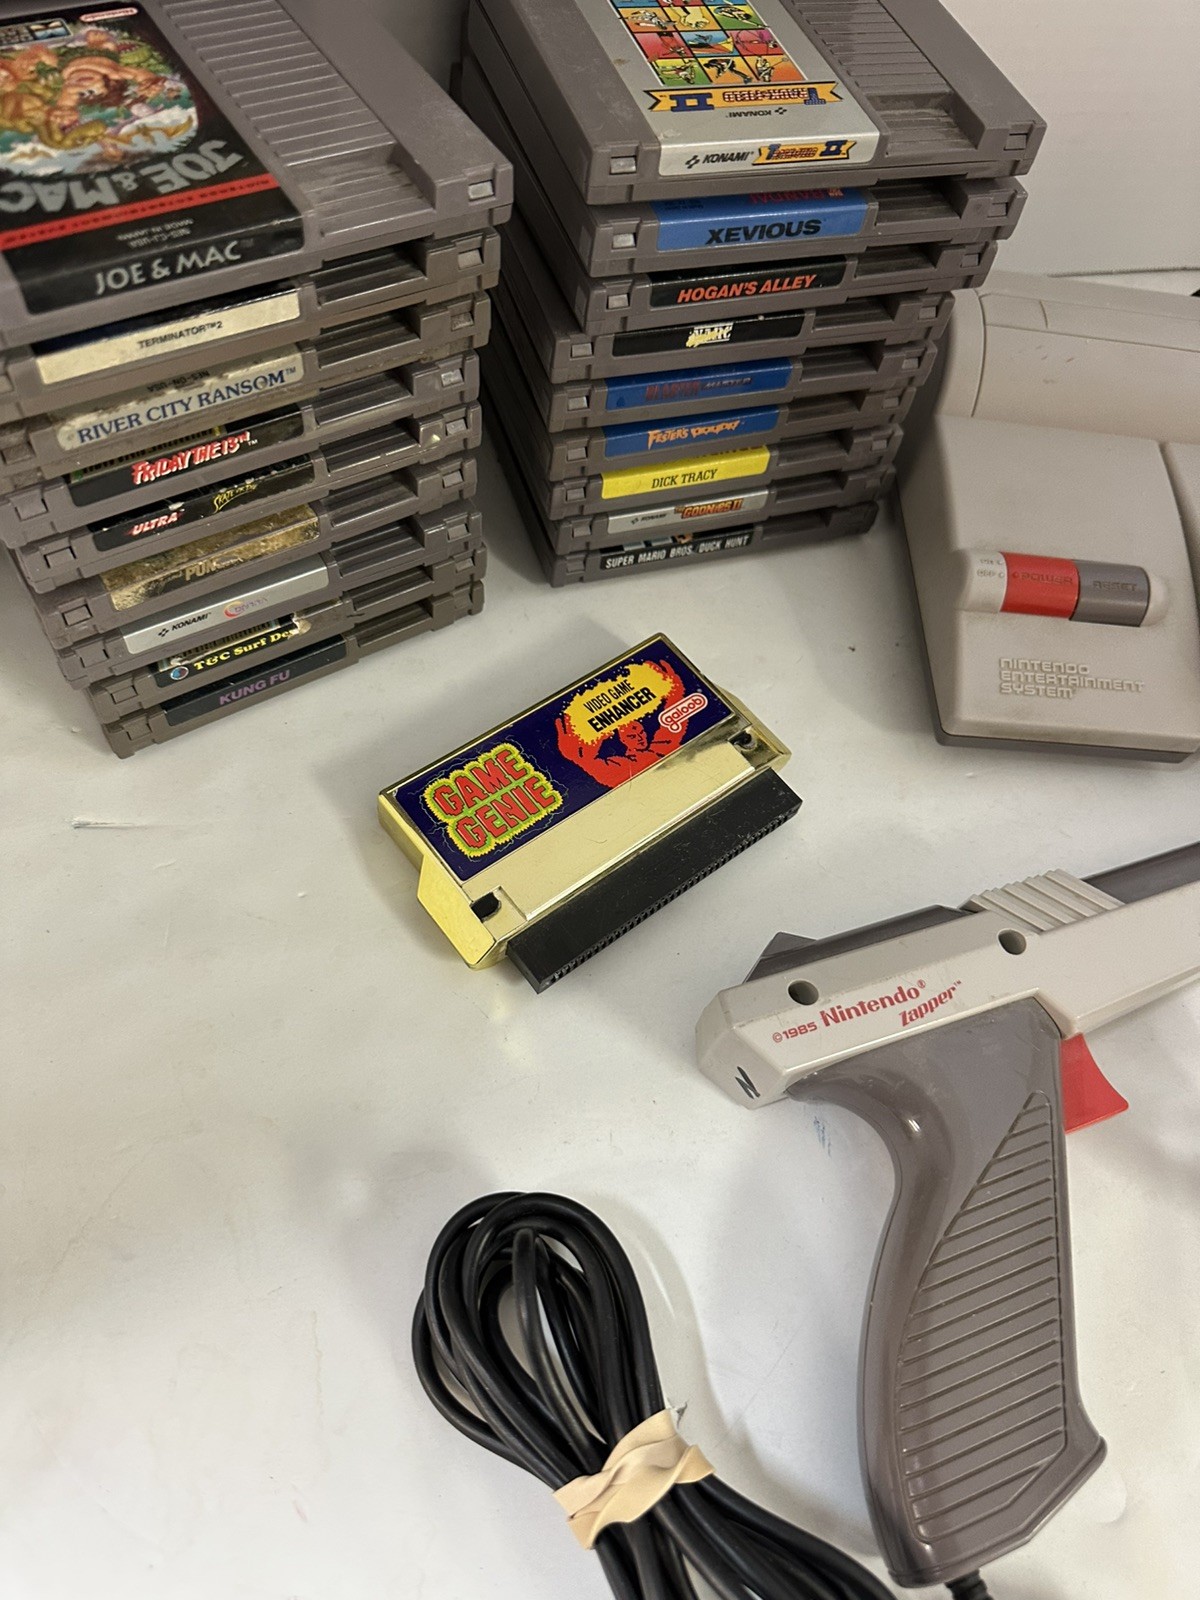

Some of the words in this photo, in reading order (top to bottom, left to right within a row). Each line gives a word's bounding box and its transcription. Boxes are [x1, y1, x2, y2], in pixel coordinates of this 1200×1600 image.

[670, 92, 715, 112] II
[728, 109, 772, 118] KONAMI
[140, 140, 243, 193] JOE
[702, 150, 751, 165] KONAMI
[0, 175, 120, 213] MAC
[113, 172, 137, 192] &
[705, 218, 822, 246] XEVIOUS
[95, 262, 146, 295] JOE
[151, 259, 171, 279] &
[175, 240, 242, 275] MAC
[676, 280, 757, 304] HOGAN'S
[760, 273, 817, 293] ALLEY
[77, 412, 143, 443] RIVER
[146, 399, 193, 427] CITY
[647, 427, 689, 449] FESTER'S
[131, 451, 193, 485] FRIDAY
[651, 475, 678, 489] DICK
[681, 468, 718, 484] TRACY
[131, 511, 179, 536] ULTRA
[605, 556, 635, 569] SUPER
[638, 549, 666, 564] MARIO
[724, 535, 750, 549] HUNT
[1021, 571, 1073, 584] POWER
[1092, 580, 1138, 592] RESET
[171, 612, 209, 631] KONAMI
[194, 650, 230, 670] T&C
[234, 636, 268, 657] Surf
[1000, 658, 1090, 675] NINTENDO
[219, 679, 267, 706] KUNG
[270, 669, 291, 689] FU
[1000, 670, 1145, 692] ENTERTAINMENT
[1000, 682, 1073, 698] SYSTEM
[582, 690, 611, 714] VIDEO
[607, 679, 636, 702] GAME
[588, 686, 657, 733] ENHANCER
[664, 695, 704, 730] galoob
[430, 747, 528, 817] GAME
[454, 776, 556, 850] GENIE
